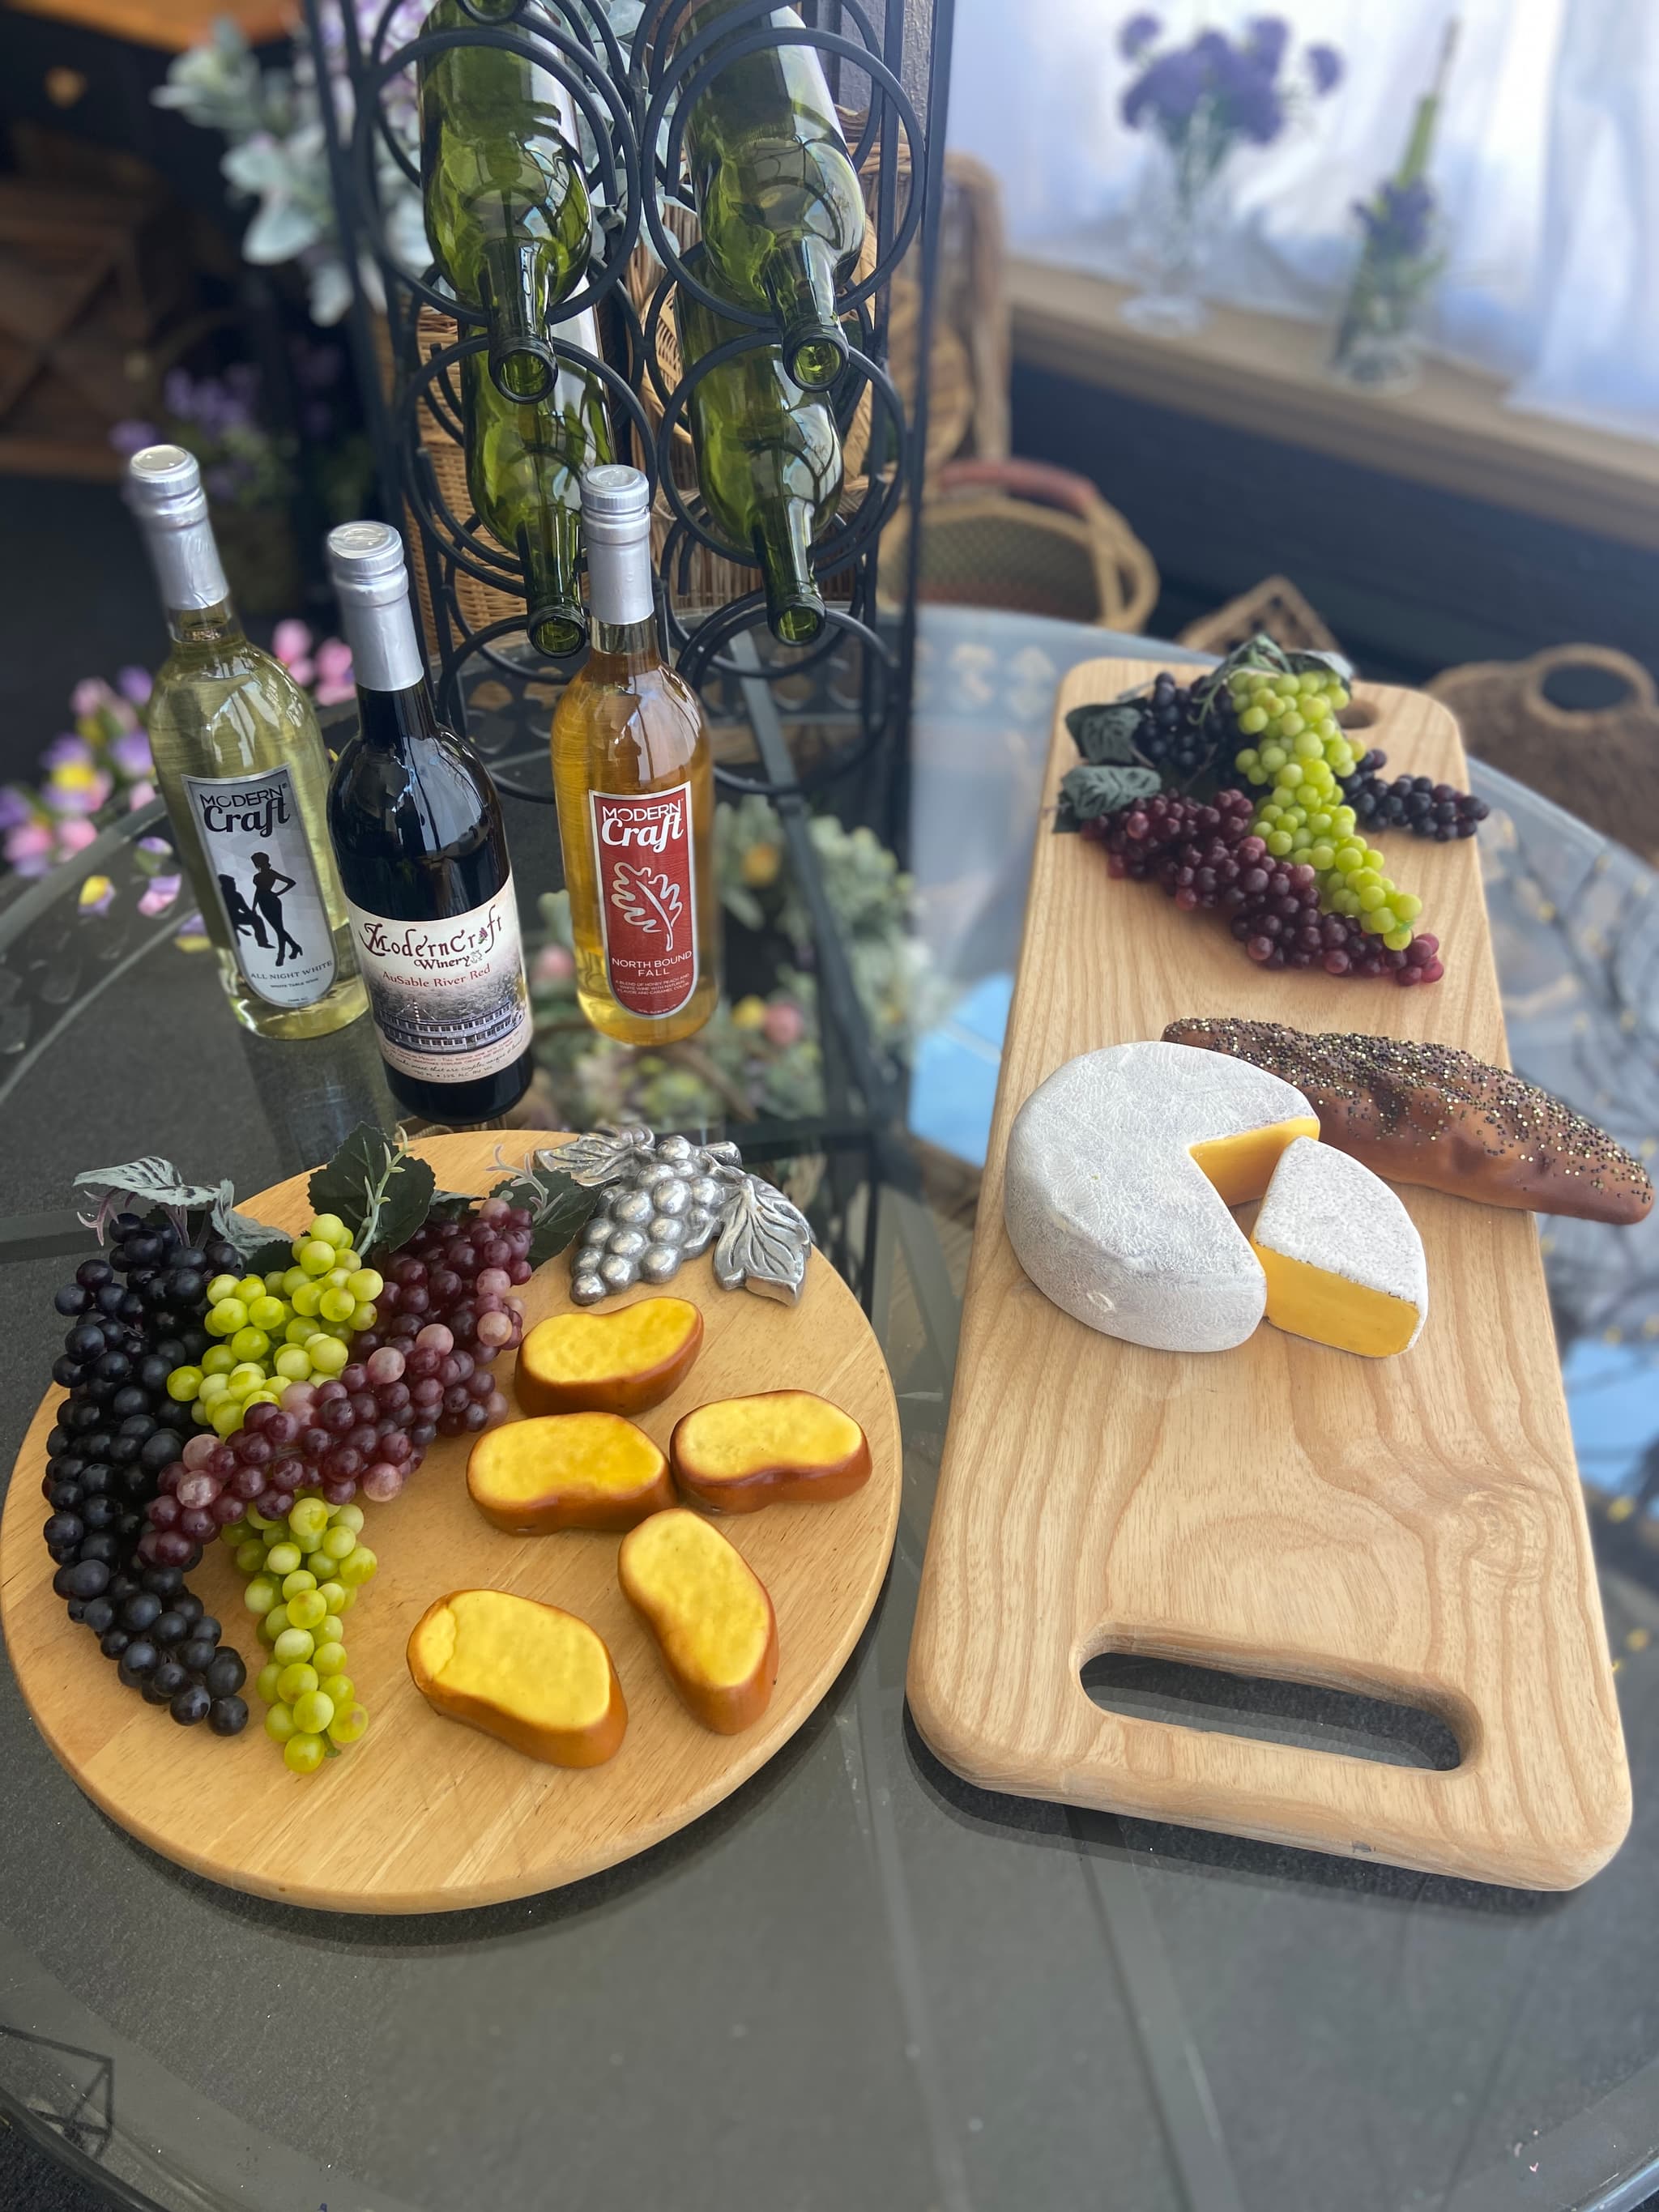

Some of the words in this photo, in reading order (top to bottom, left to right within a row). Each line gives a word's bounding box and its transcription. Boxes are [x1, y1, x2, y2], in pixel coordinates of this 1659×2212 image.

[204, 796, 291, 837] Craft
[601, 812, 684, 854] Craft
[413, 954, 470, 971] Winery
[612, 957, 651, 969] NORTH
[654, 950, 693, 968] BOUND
[270, 971, 300, 979] NIGHT
[301, 960, 333, 975] WHITE
[382, 971, 430, 987] AuSable
[433, 975, 467, 987] River
[469, 963, 491, 980] Red
[638, 967, 671, 977] FALL
